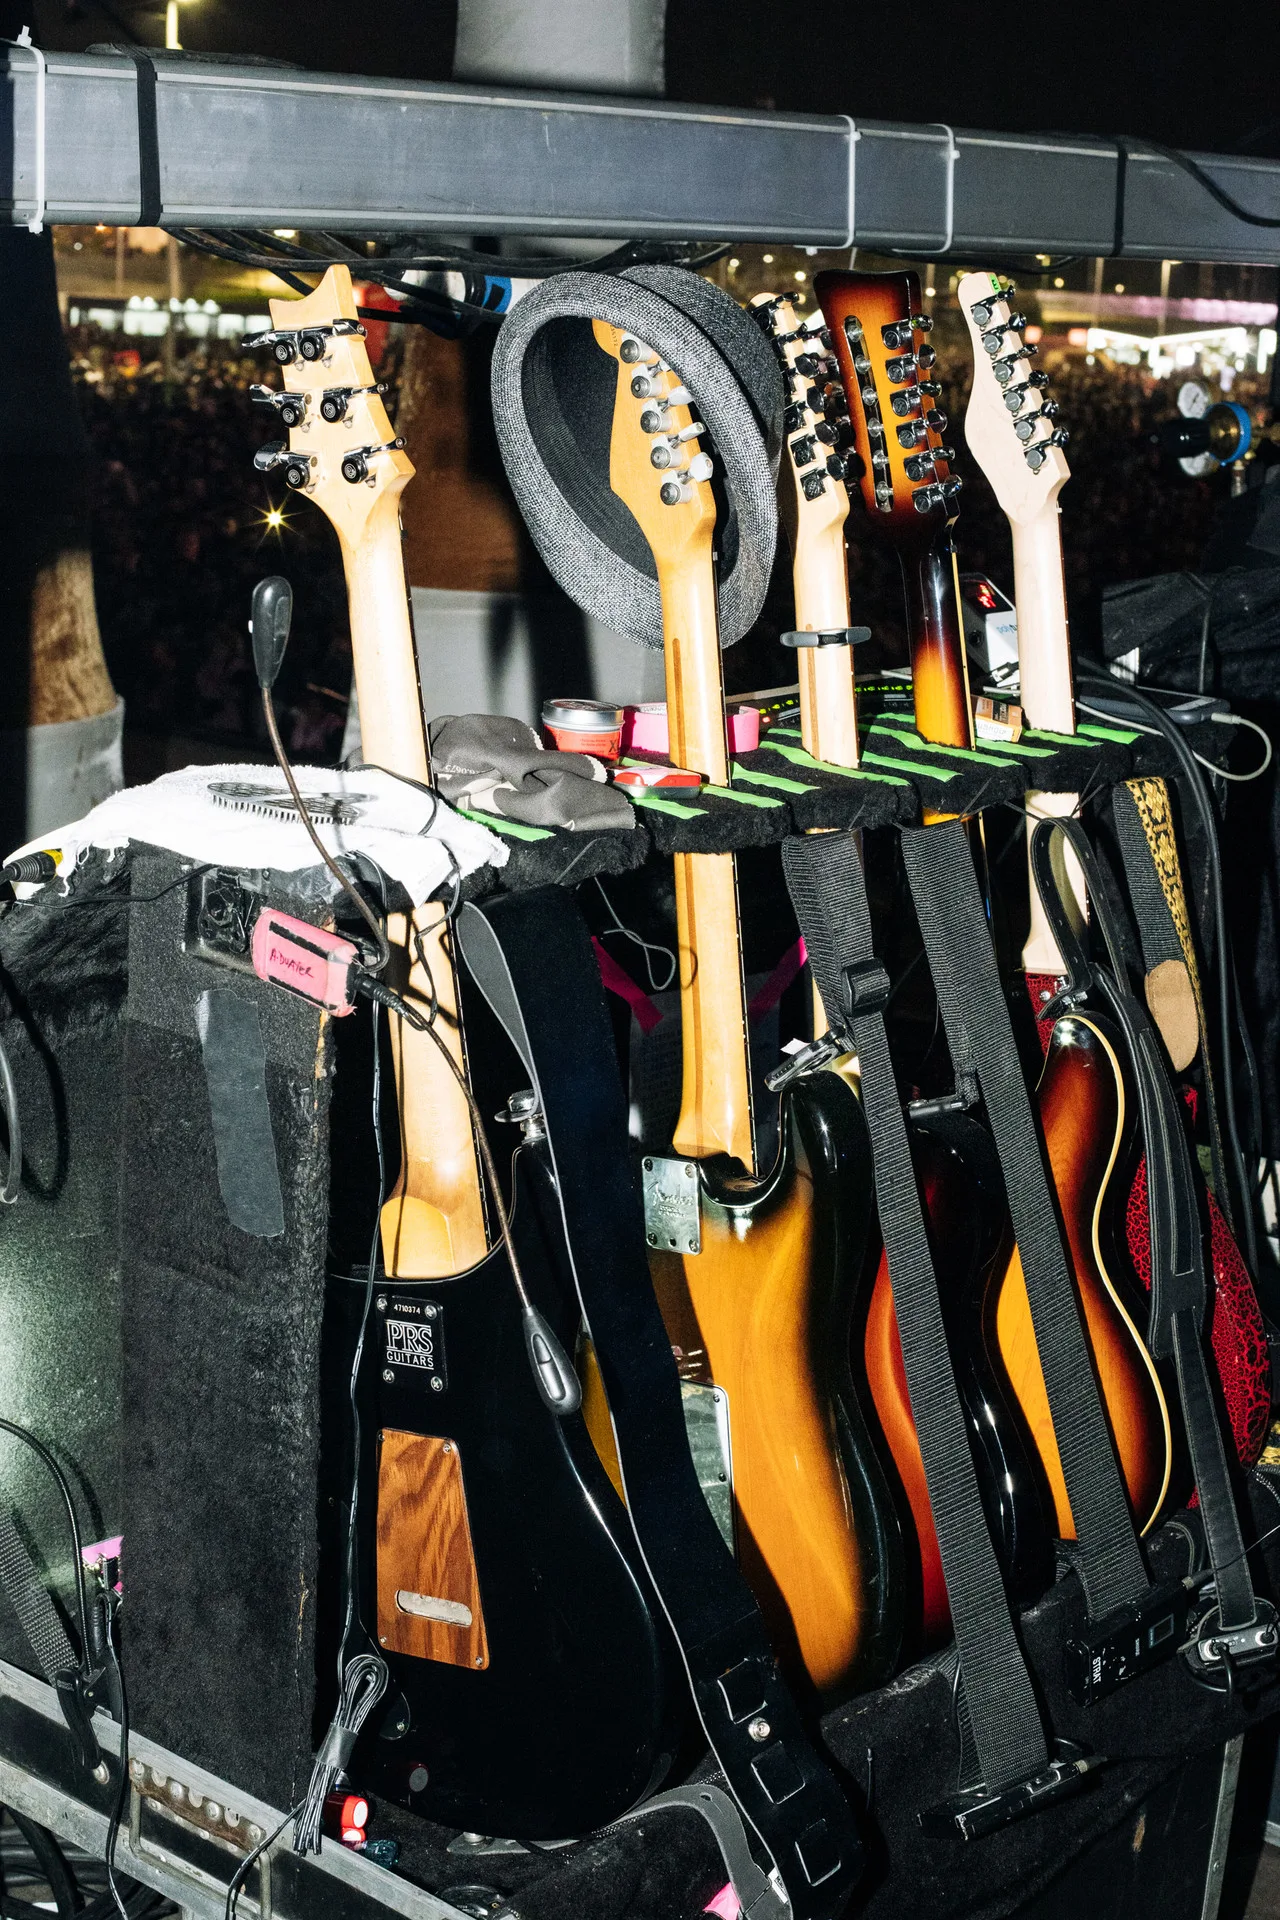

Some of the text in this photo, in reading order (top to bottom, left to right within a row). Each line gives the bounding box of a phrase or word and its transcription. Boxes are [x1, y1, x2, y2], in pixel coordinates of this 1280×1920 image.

[393, 1303, 421, 1315] 4710374
[385, 1321, 434, 1355] PRS
[386, 1350, 434, 1368] GUITARS
[1092, 1656, 1102, 1685] STRAT
